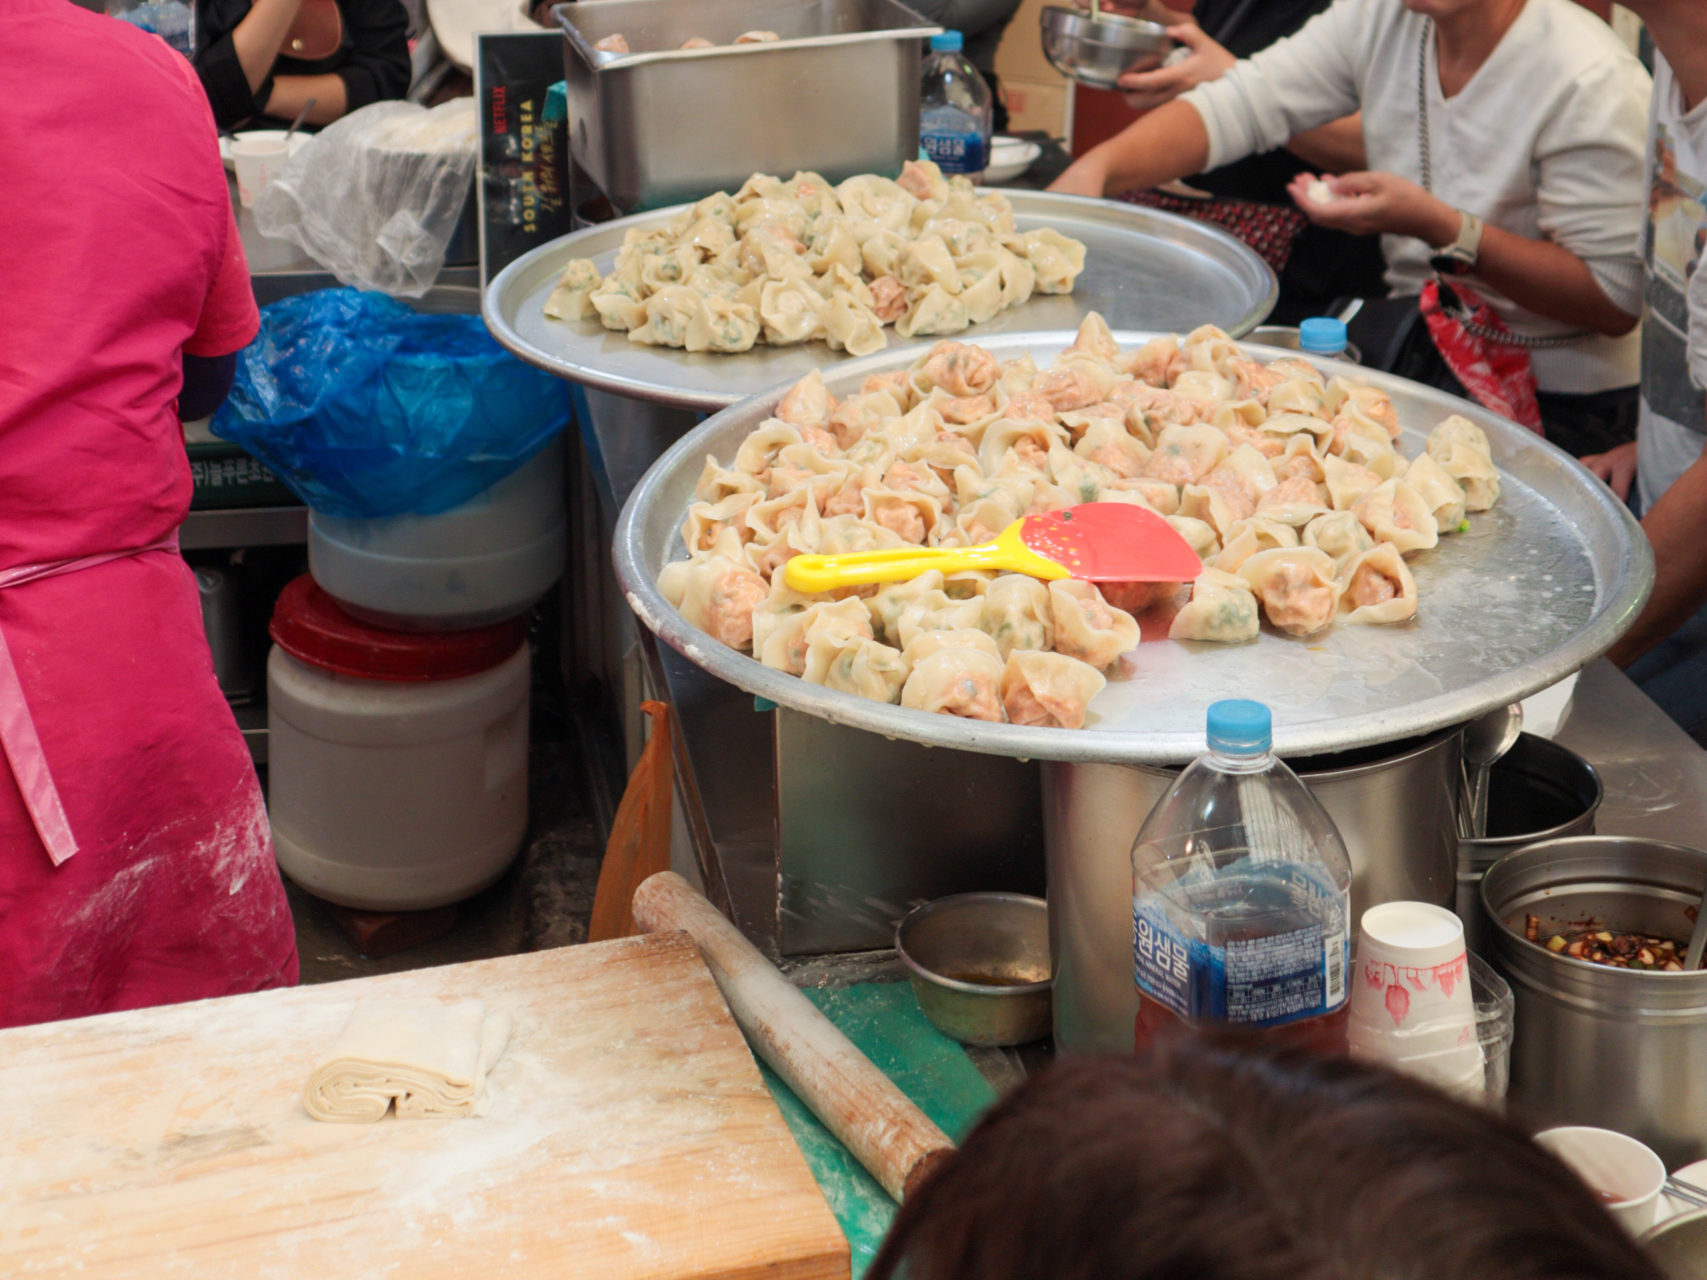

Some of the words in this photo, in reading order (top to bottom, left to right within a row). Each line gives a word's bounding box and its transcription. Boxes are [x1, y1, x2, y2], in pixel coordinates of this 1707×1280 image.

[492, 85, 507, 134] NETFLIX
[519, 99, 534, 163] KOREA
[521, 171, 537, 233] SOUTH
[1134, 916, 1191, 984] 원샘물
